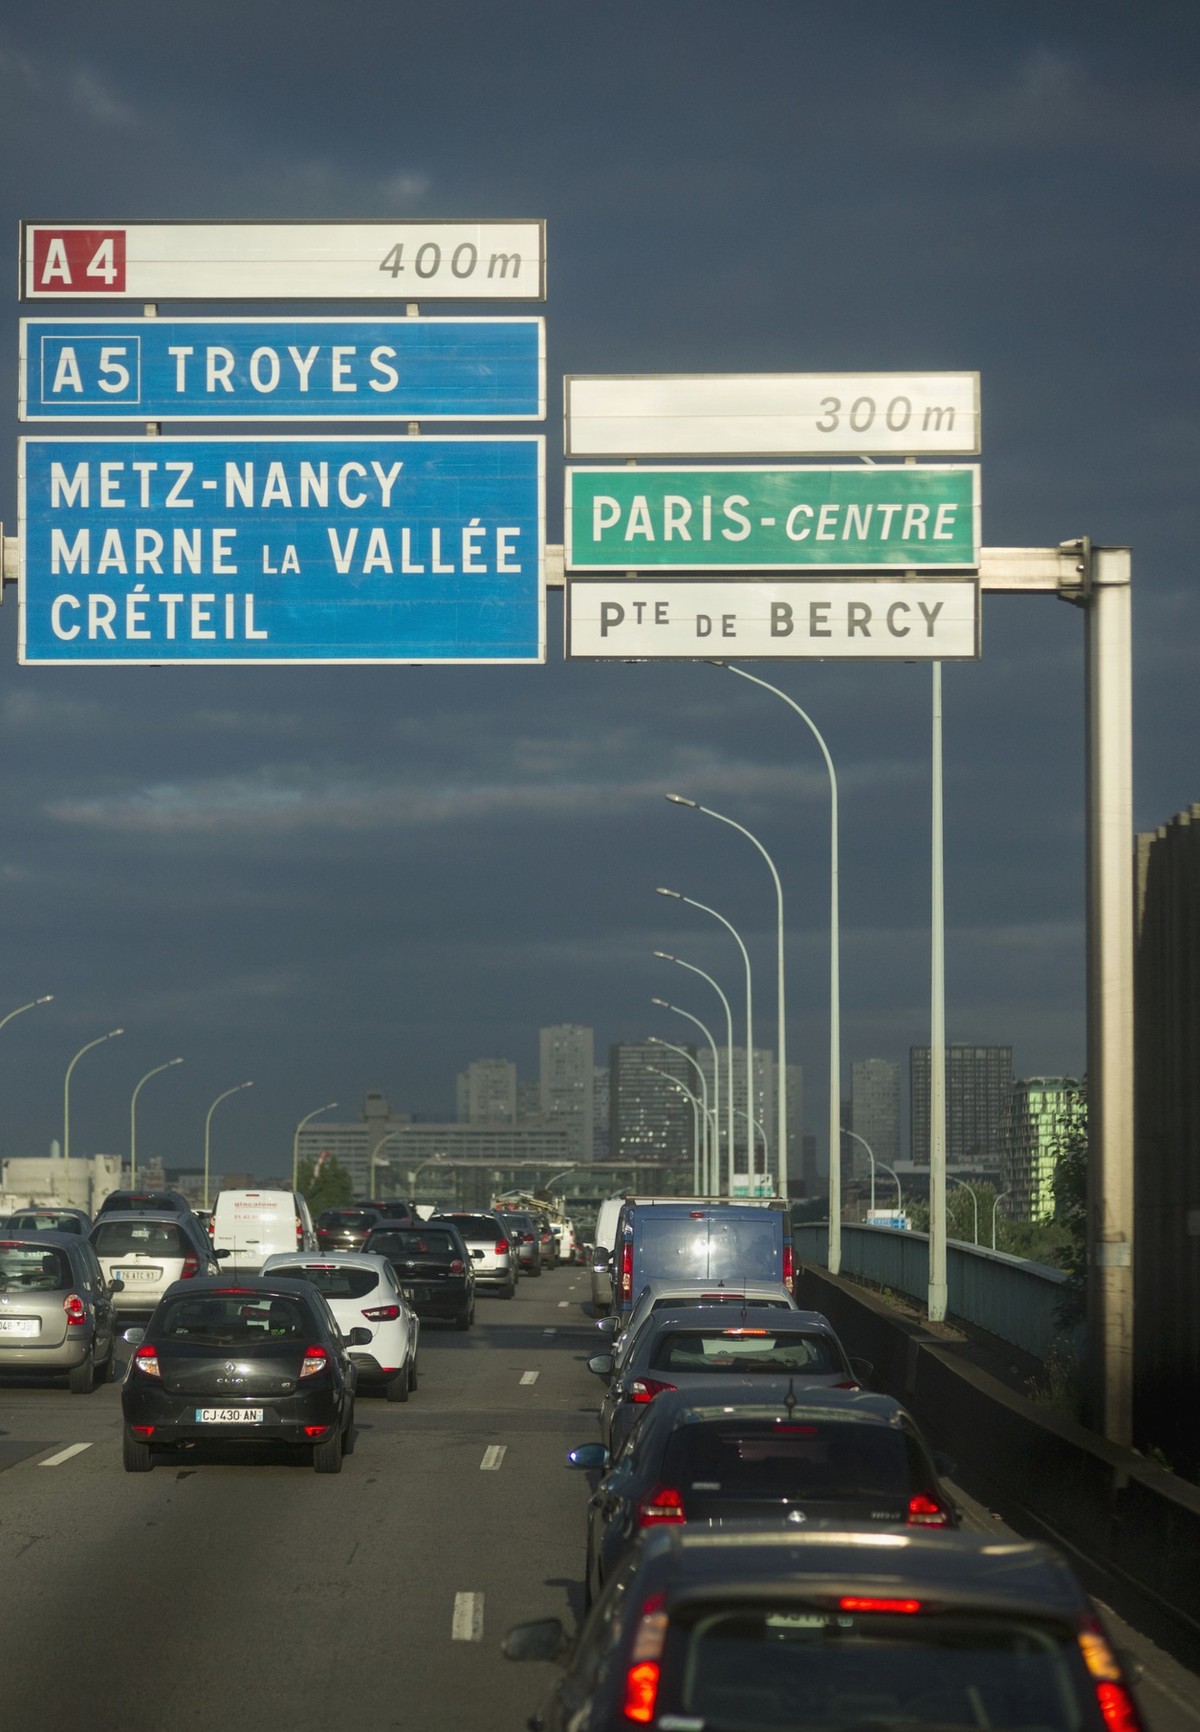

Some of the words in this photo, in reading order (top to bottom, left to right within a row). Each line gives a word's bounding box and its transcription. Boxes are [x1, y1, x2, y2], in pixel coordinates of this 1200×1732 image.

[168, 345, 400, 393] TROYES
[50, 461, 404, 508] METZ-NANCY
[50, 528, 238, 575] MARNE
[262, 544, 301, 574] LA
[327, 518, 523, 574] VALLÉE
[50, 583, 269, 640] CRÉTEIL
[695, 614, 737, 638] DE
[770, 601, 945, 638] BERCY
